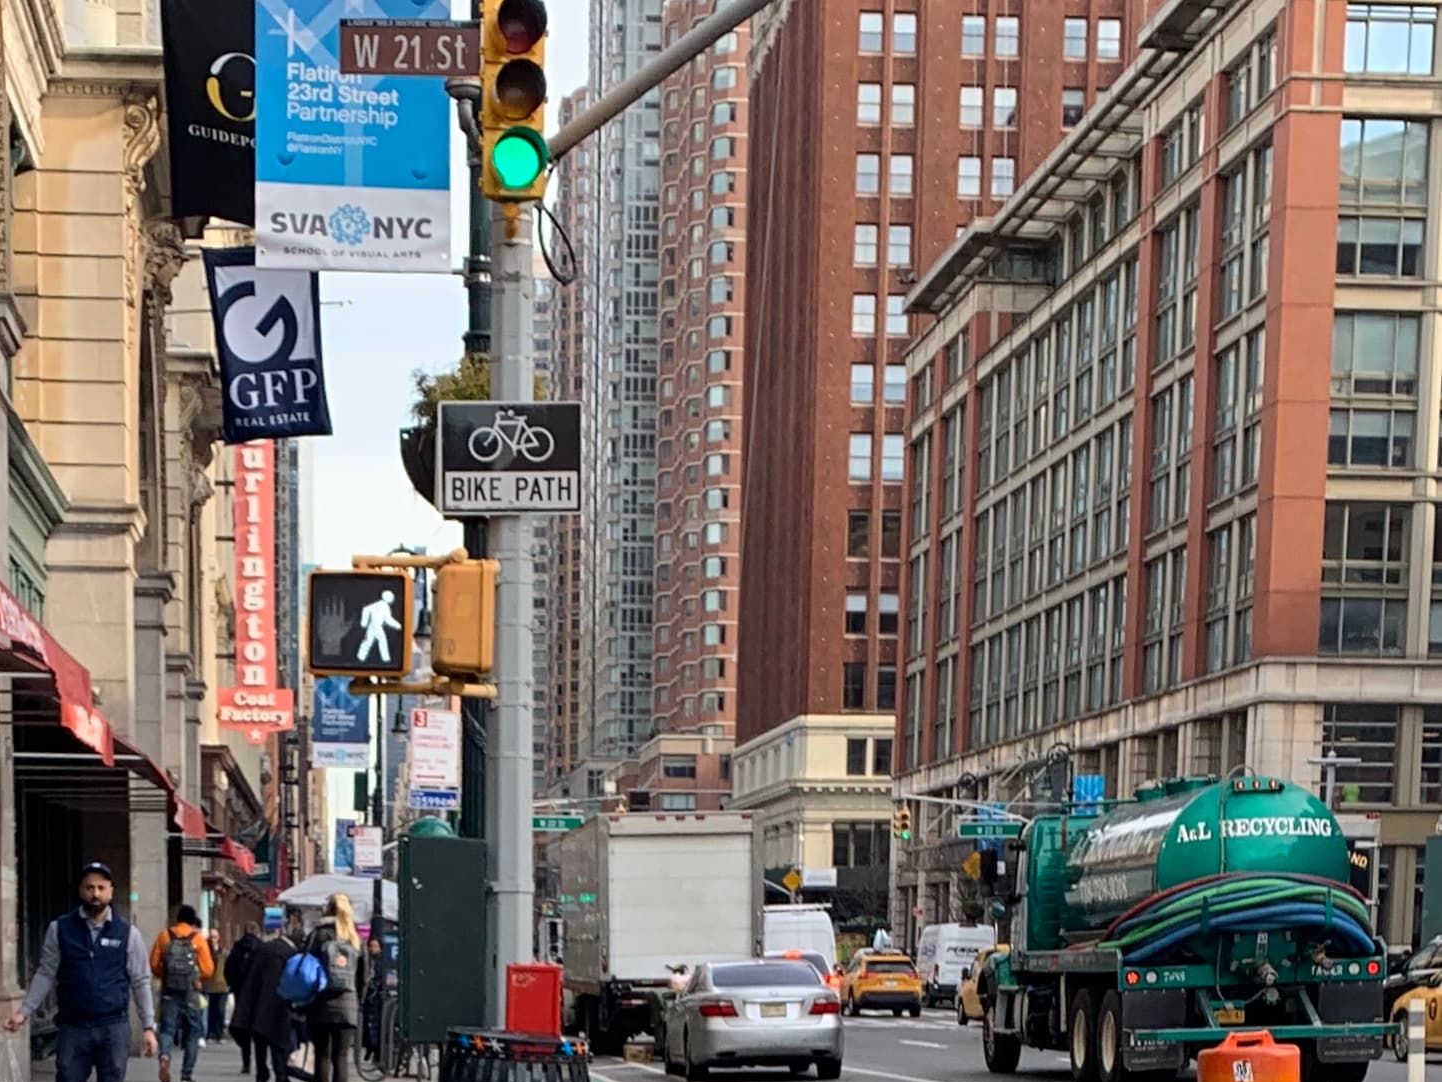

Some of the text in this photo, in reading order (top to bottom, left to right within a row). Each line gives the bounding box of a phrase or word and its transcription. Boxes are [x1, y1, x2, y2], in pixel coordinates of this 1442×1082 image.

[353, 34, 466, 69] W 21 St
[287, 82, 399, 106] 23rd Street
[286, 101, 399, 130] Partnership
[270, 212, 433, 239] SVA NYC
[283, 247, 422, 259] SCHOOL OF VISUAL ARTS
[229, 368, 318, 410] GFP
[235, 411, 311, 427] REAL ESTATE
[452, 477, 571, 501] BIKE PATH
[240, 438, 267, 686] urlington
[233, 691, 276, 706] Coat
[220, 706, 290, 725] Factory
[1221, 816, 1332, 838] RECYCLING
